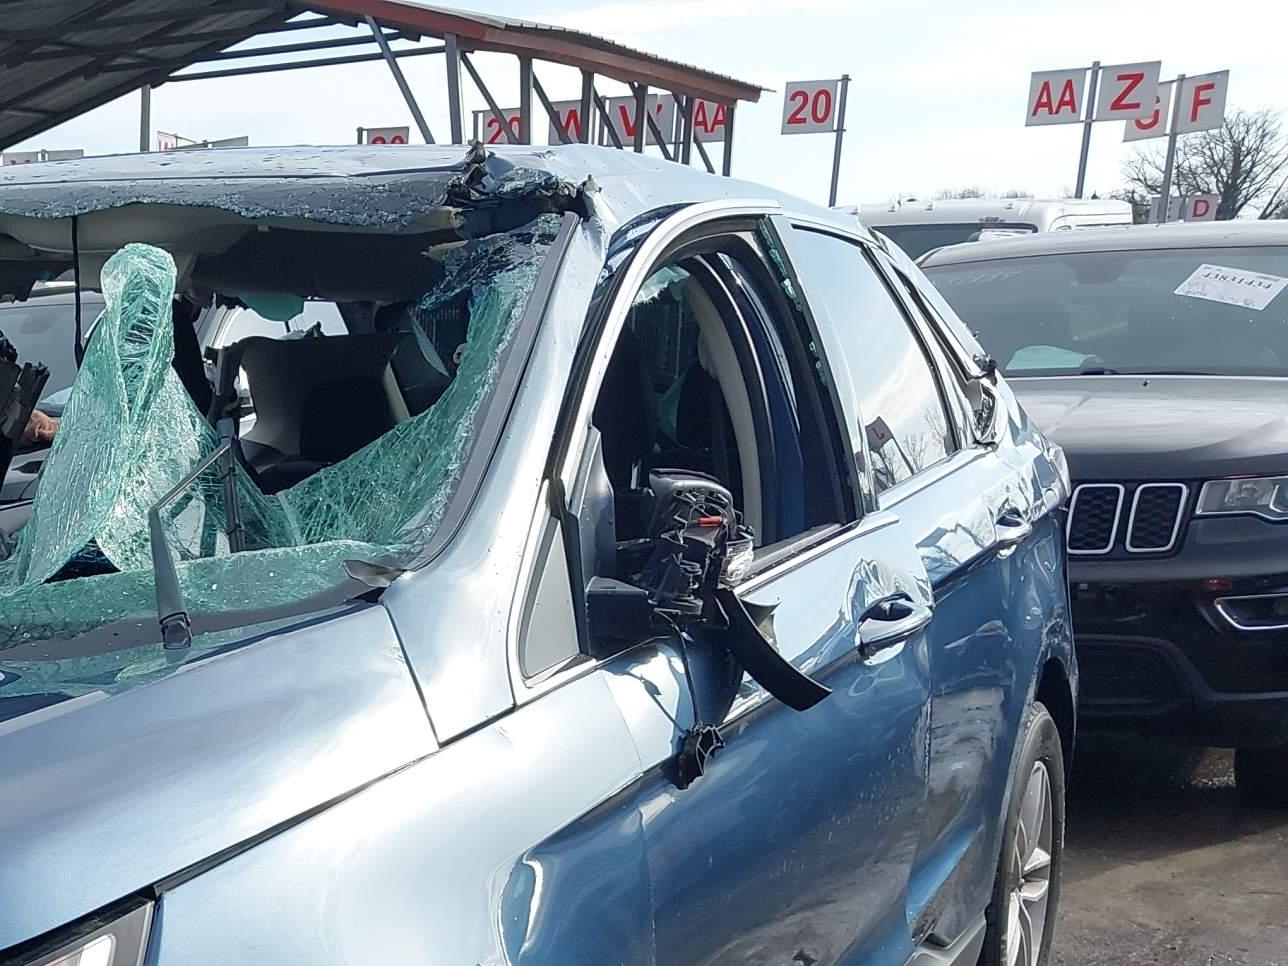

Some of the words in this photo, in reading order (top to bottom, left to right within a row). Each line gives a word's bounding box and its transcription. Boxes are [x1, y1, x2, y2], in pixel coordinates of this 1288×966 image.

[786, 88, 832, 125] 20
[1031, 79, 1077, 117] AA
[1110, 72, 1145, 112] Z
[1190, 83, 1215, 122] F
[694, 101, 728, 133] AA
[1191, 200, 1210, 218] D
